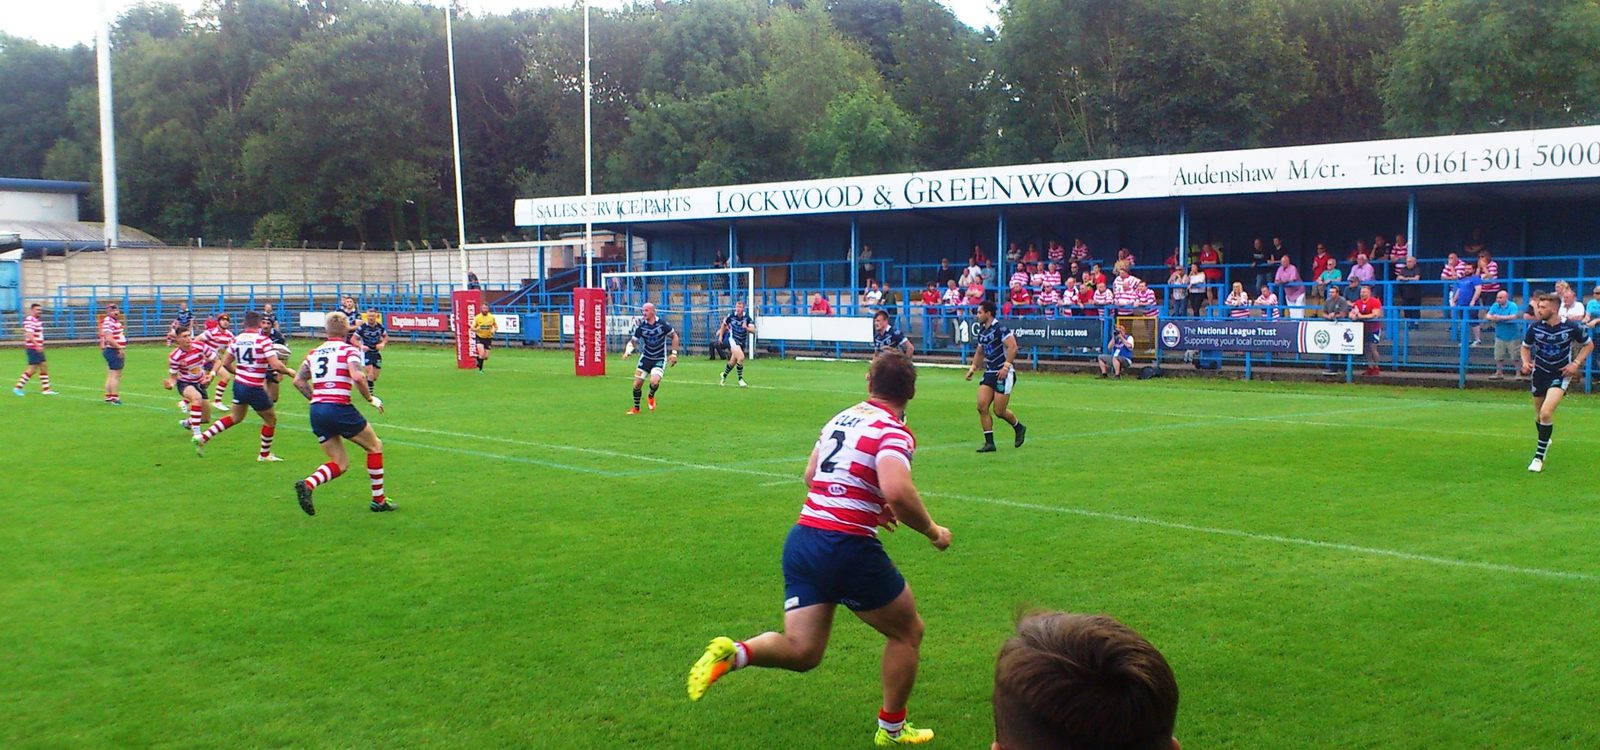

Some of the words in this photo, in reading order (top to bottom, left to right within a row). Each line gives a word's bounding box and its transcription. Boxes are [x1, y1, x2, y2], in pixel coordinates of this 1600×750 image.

[1172, 162, 1277, 187] Audenshaw
[1368, 153, 1405, 177] Tel:
[1416, 147, 1521, 176] 0161-301
[1532, 141, 1600, 168] 5000
[716, 185, 863, 214] LOCKWOOD
[873, 183, 894, 207] &
[903, 168, 1130, 206] GREENWOOD
[536, 202, 578, 219] SALES
[580, 199, 640, 217] SERVICE
[644, 196, 692, 214] PARTS
[594, 304, 602, 329] CIDER
[1184, 327, 1196, 335] The
[1197, 327, 1228, 335] National
[1229, 327, 1256, 337] League
[1257, 328, 1277, 336] Trust
[1184, 336, 1219, 346] Supporting
[1219, 338, 1234, 346] your
[1236, 337, 1252, 345] local
[1253, 338, 1291, 348] community
[235, 347, 256, 365] 14
[578, 322, 586, 367] Kingstone
[594, 330, 602, 363] PROPER
[314, 356, 329, 379] 3
[835, 414, 865, 428] CLAY
[820, 429, 846, 474] 2
